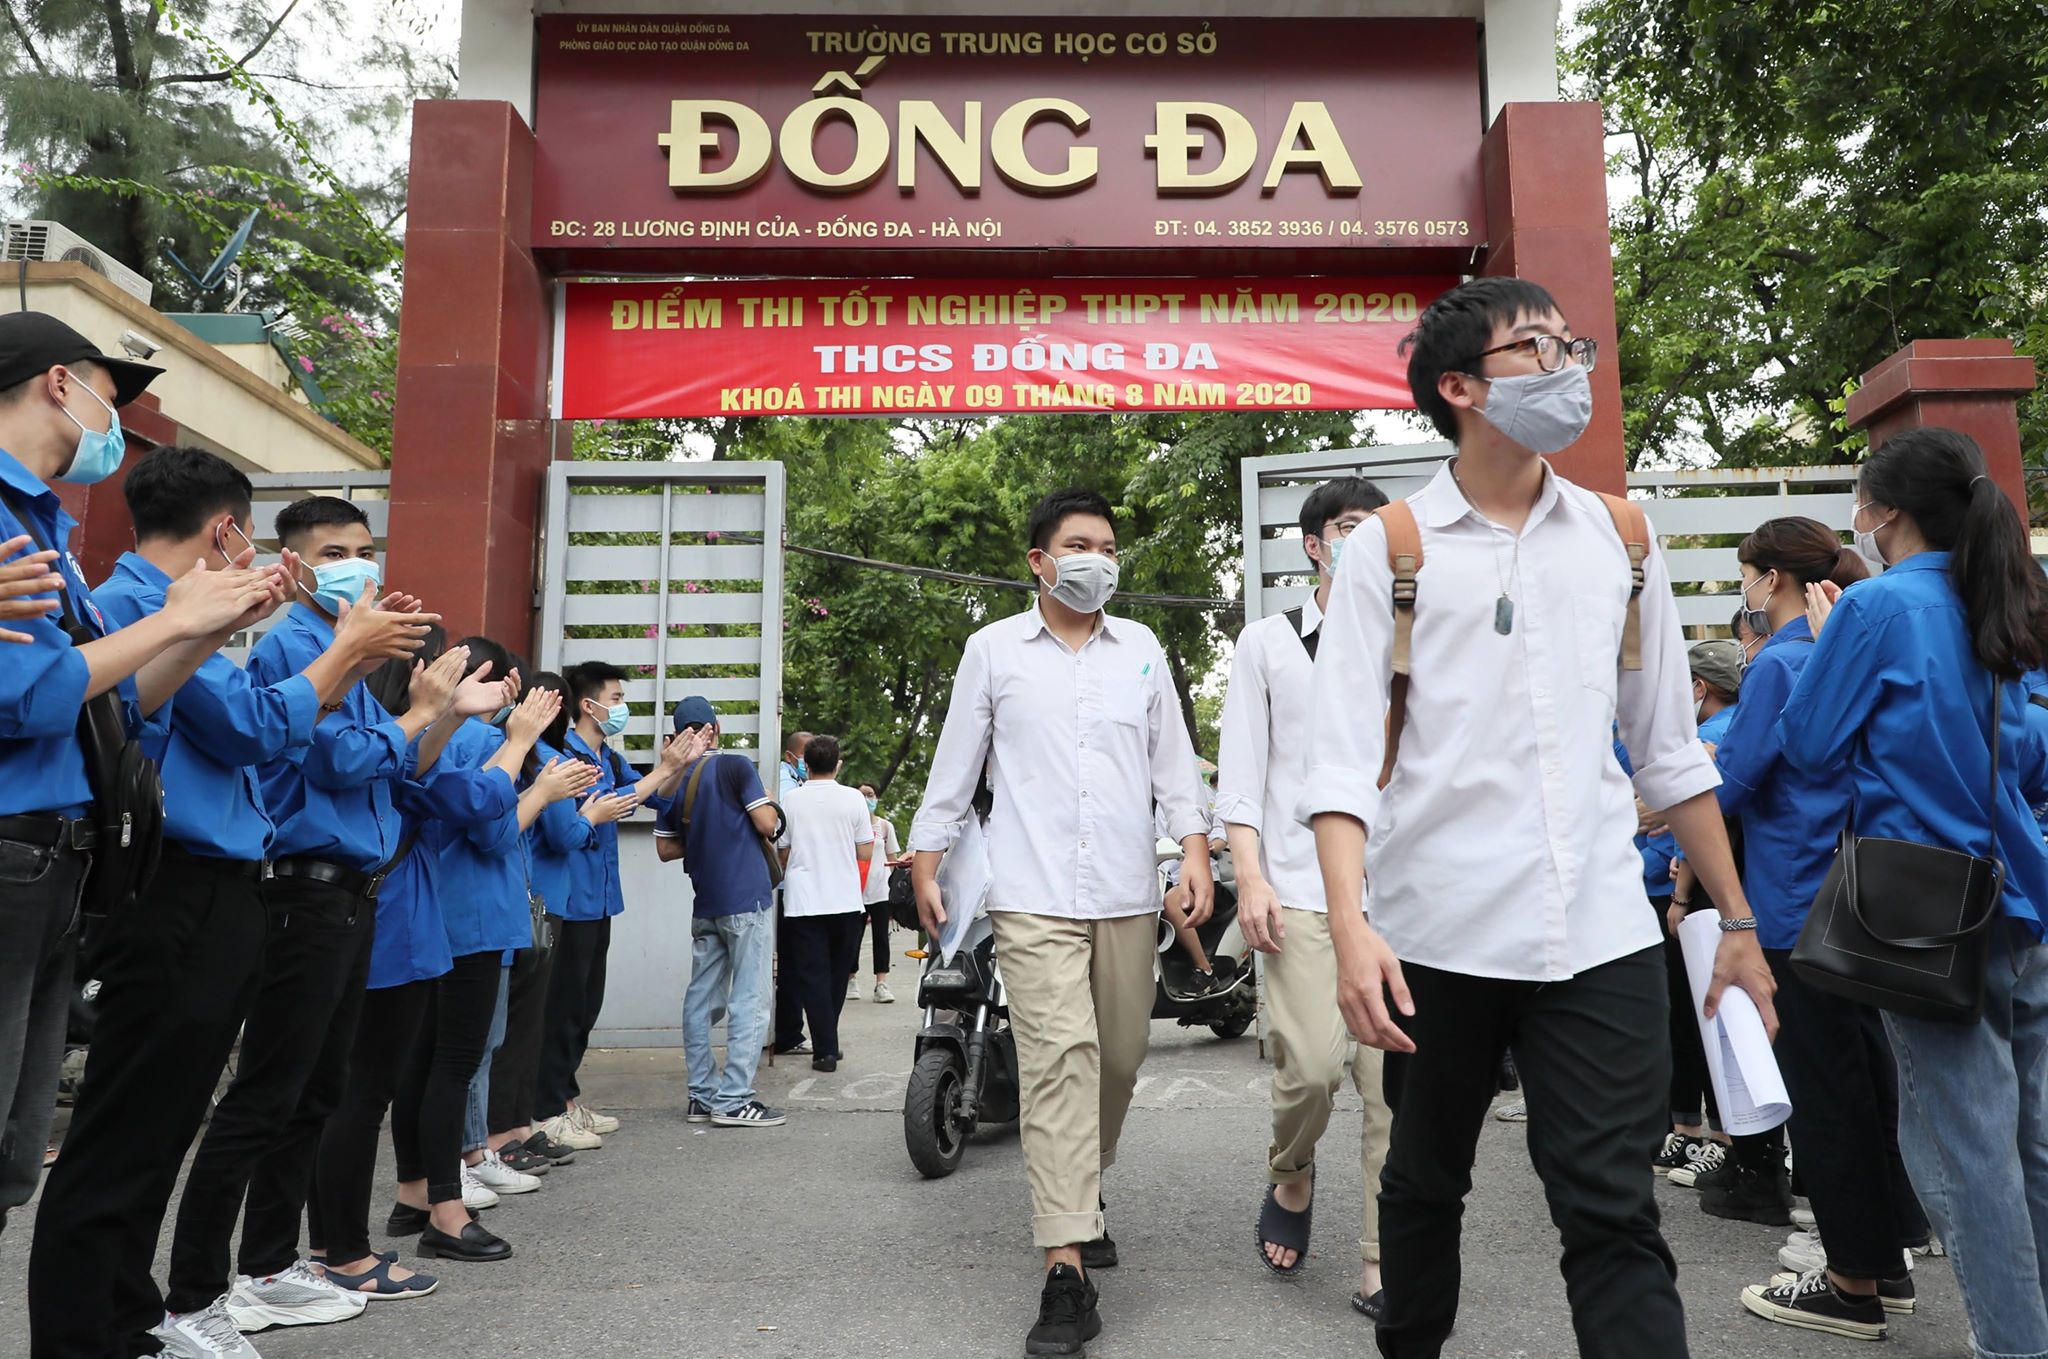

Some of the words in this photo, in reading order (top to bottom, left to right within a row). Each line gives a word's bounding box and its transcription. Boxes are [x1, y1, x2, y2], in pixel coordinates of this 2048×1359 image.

[591, 24, 610, 33] BAN
[661, 22, 687, 35] QUẬN
[806, 24, 931, 55] TRƯỜNG
[941, 31, 1043, 55] TRUNG
[1054, 31, 1117, 62] HỌC
[1125, 31, 1168, 55] CƠ
[1177, 22, 1218, 55] SỞ
[559, 38, 591, 50] PHÒNG
[592, 39, 615, 50] GIÁO
[617, 41, 636, 53] DỤC
[660, 41, 678, 53] TẠO
[658, 55, 1099, 197] ĐỐNG
[1144, 101, 1364, 196] ĐA
[550, 220, 587, 237] ĐC:
[592, 220, 616, 237] 28
[621, 219, 695, 237] LƯƠNG
[700, 221, 750, 241] ĐỊNH
[756, 215, 800, 237] CỦA
[816, 215, 878, 237] ĐỐNG
[883, 221, 913, 237] ĐA
[931, 217, 961, 237] HÀ
[966, 218, 1002, 241] NỘI
[1154, 220, 1188, 236] ĐT:
[1194, 220, 1222, 236] 04.
[1228, 220, 1273, 236] 3852
[1278, 220, 1323, 236] 3936
[1328, 220, 1334, 236] /
[1339, 220, 1368, 236] 04.
[1374, 220, 1419, 236] 3576
[1424, 220, 1469, 236] 0573
[611, 286, 722, 330] ĐIỂM
[737, 296, 803, 328] THI
[817, 285, 893, 327] TỐT
[907, 288, 1067, 331] NGHIỆP
[1081, 294, 1185, 325] THPT
[1200, 288, 1299, 324] NĂM
[1314, 293, 1418, 324] 2020
[813, 344, 953, 374] THCS
[971, 334, 1126, 372] ĐỐNG
[1142, 342, 1219, 371] ĐA
[720, 382, 804, 411] KHOÁ
[814, 385, 861, 410] THI
[872, 382, 953, 409] NGÀY
[965, 384, 1003, 408] 09
[1013, 380, 1115, 407] THÁNG
[1125, 384, 1143, 406] 8
[1153, 379, 1226, 406] NĂM
[1236, 383, 1311, 405] 2020
